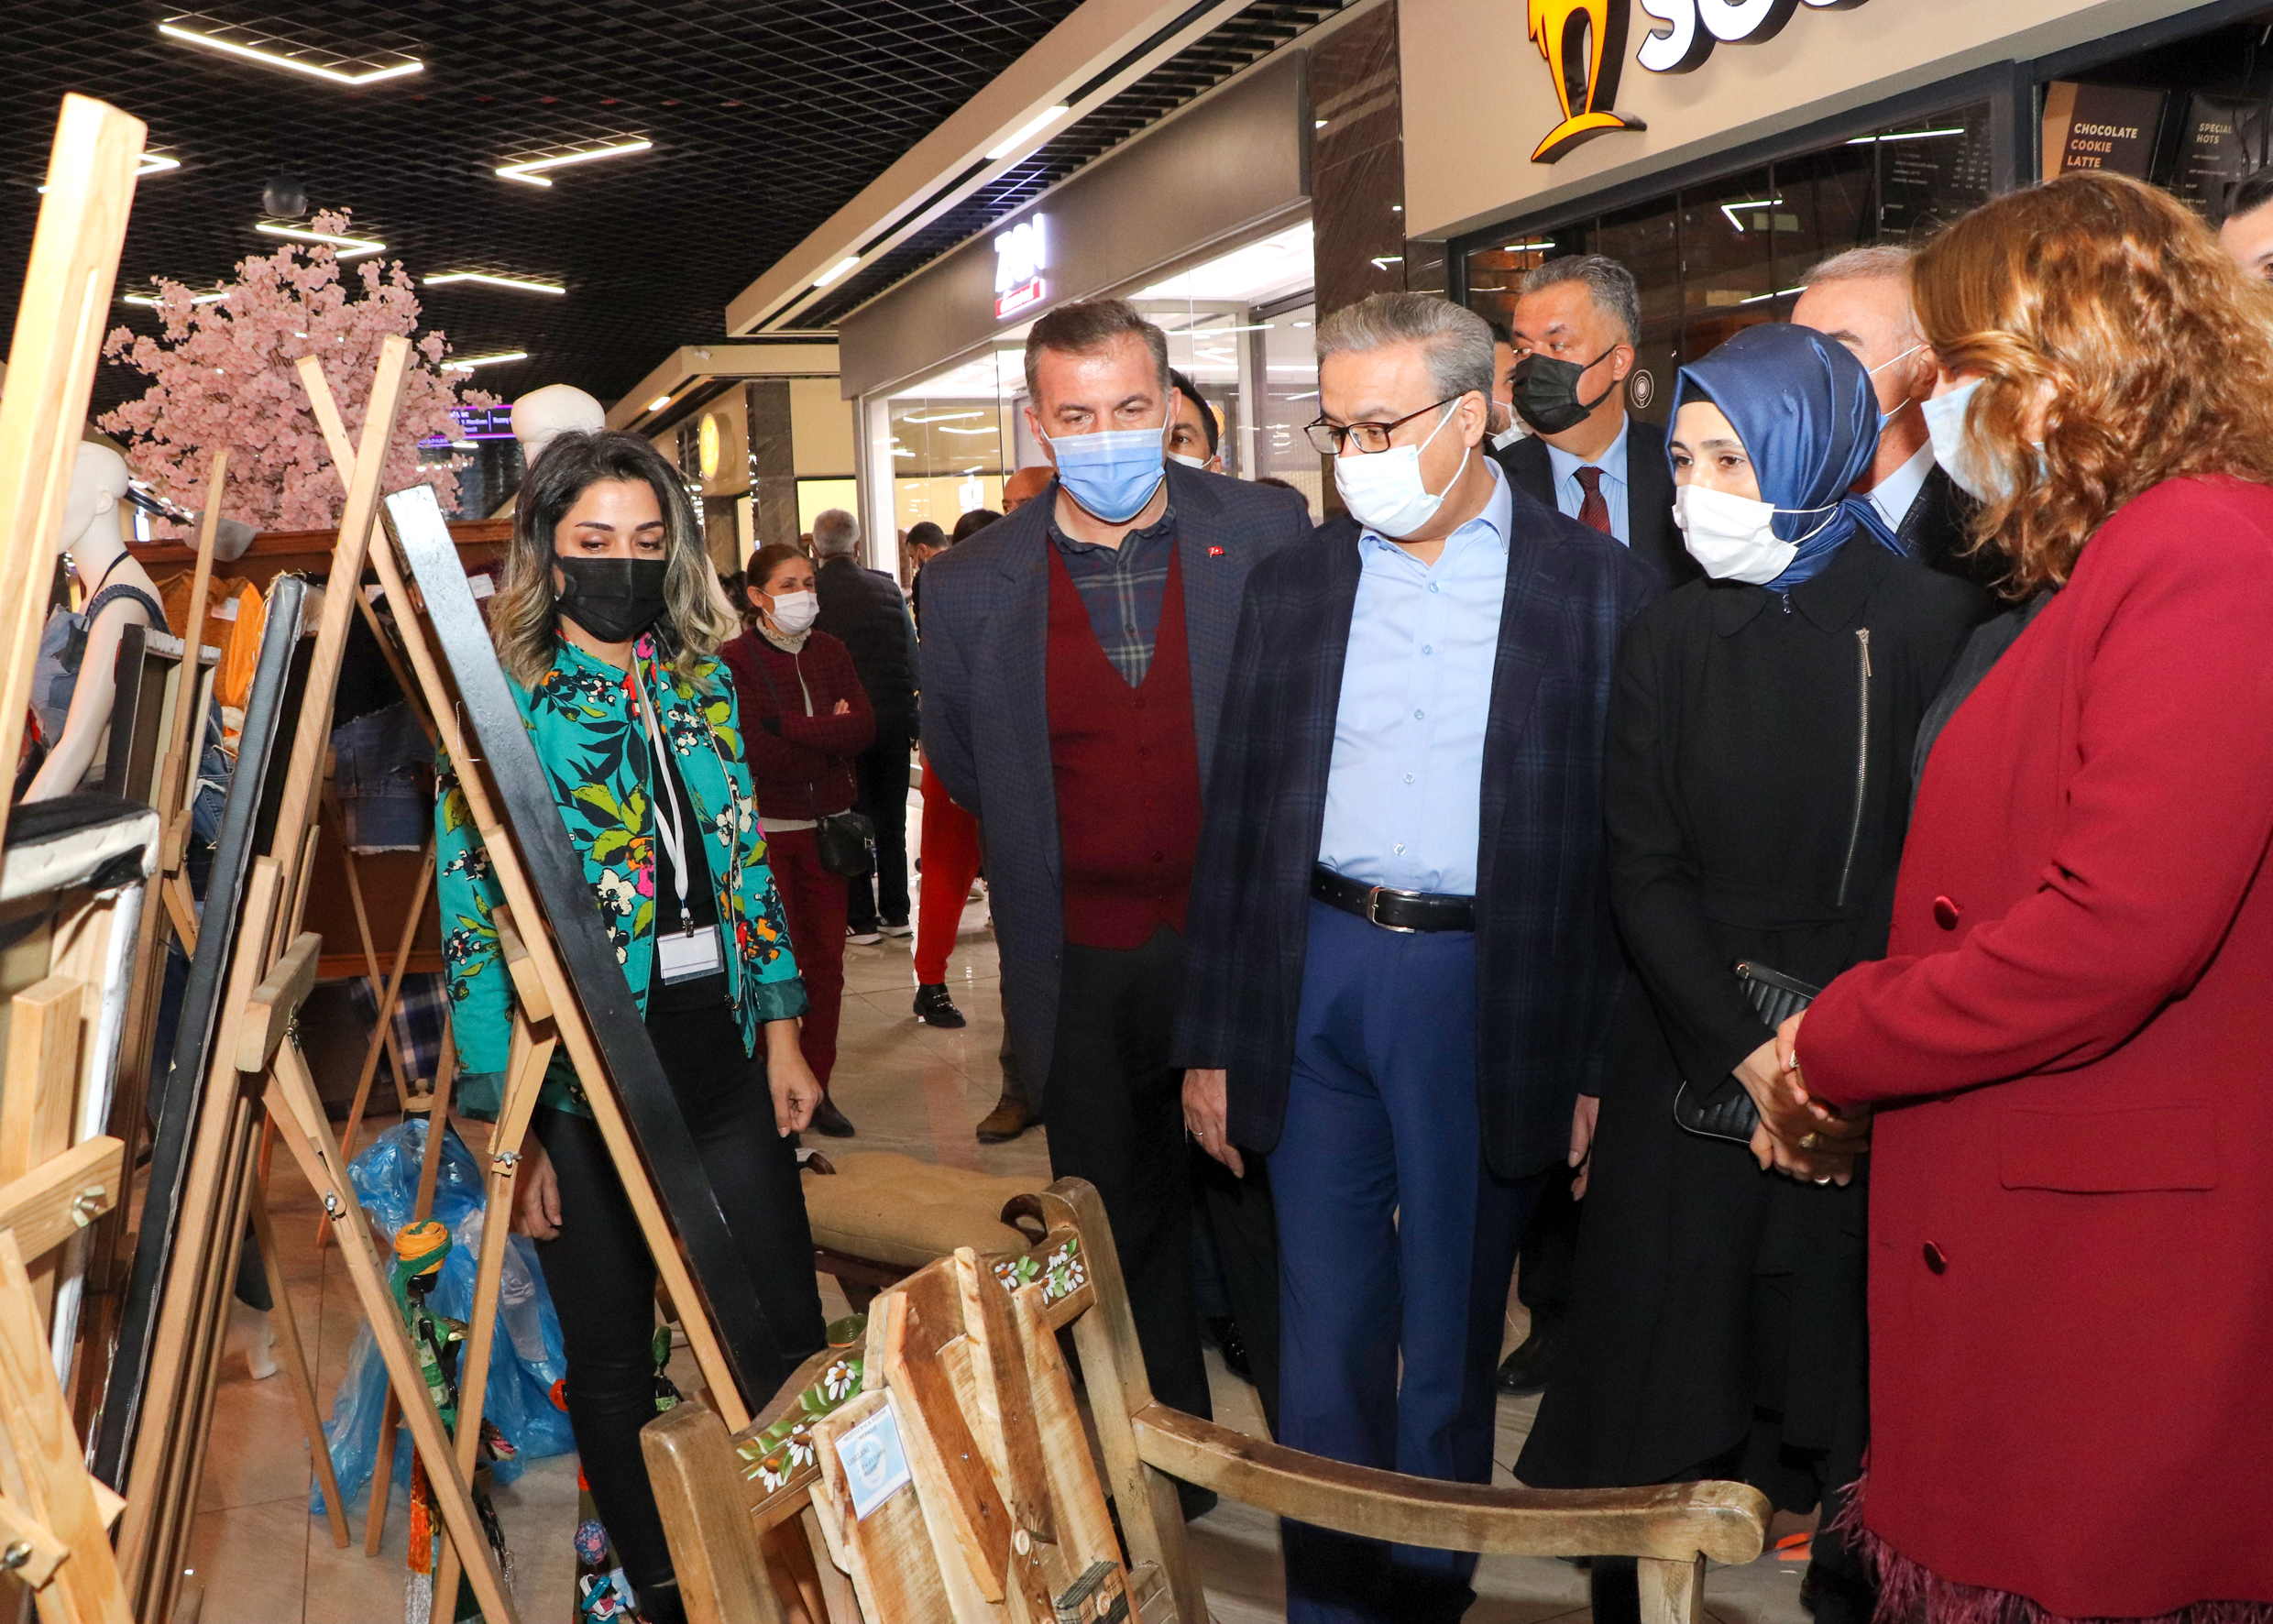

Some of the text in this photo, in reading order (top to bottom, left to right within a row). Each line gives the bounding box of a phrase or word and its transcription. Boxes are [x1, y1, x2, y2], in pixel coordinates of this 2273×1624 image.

[2073, 123, 2139, 139] CHOCOLATE
[2198, 122, 2233, 135] SPECIAL
[2070, 138, 2113, 153] COOKIE
[2196, 134, 2220, 145] HOTS
[2066, 155, 2102, 168] LATTE
